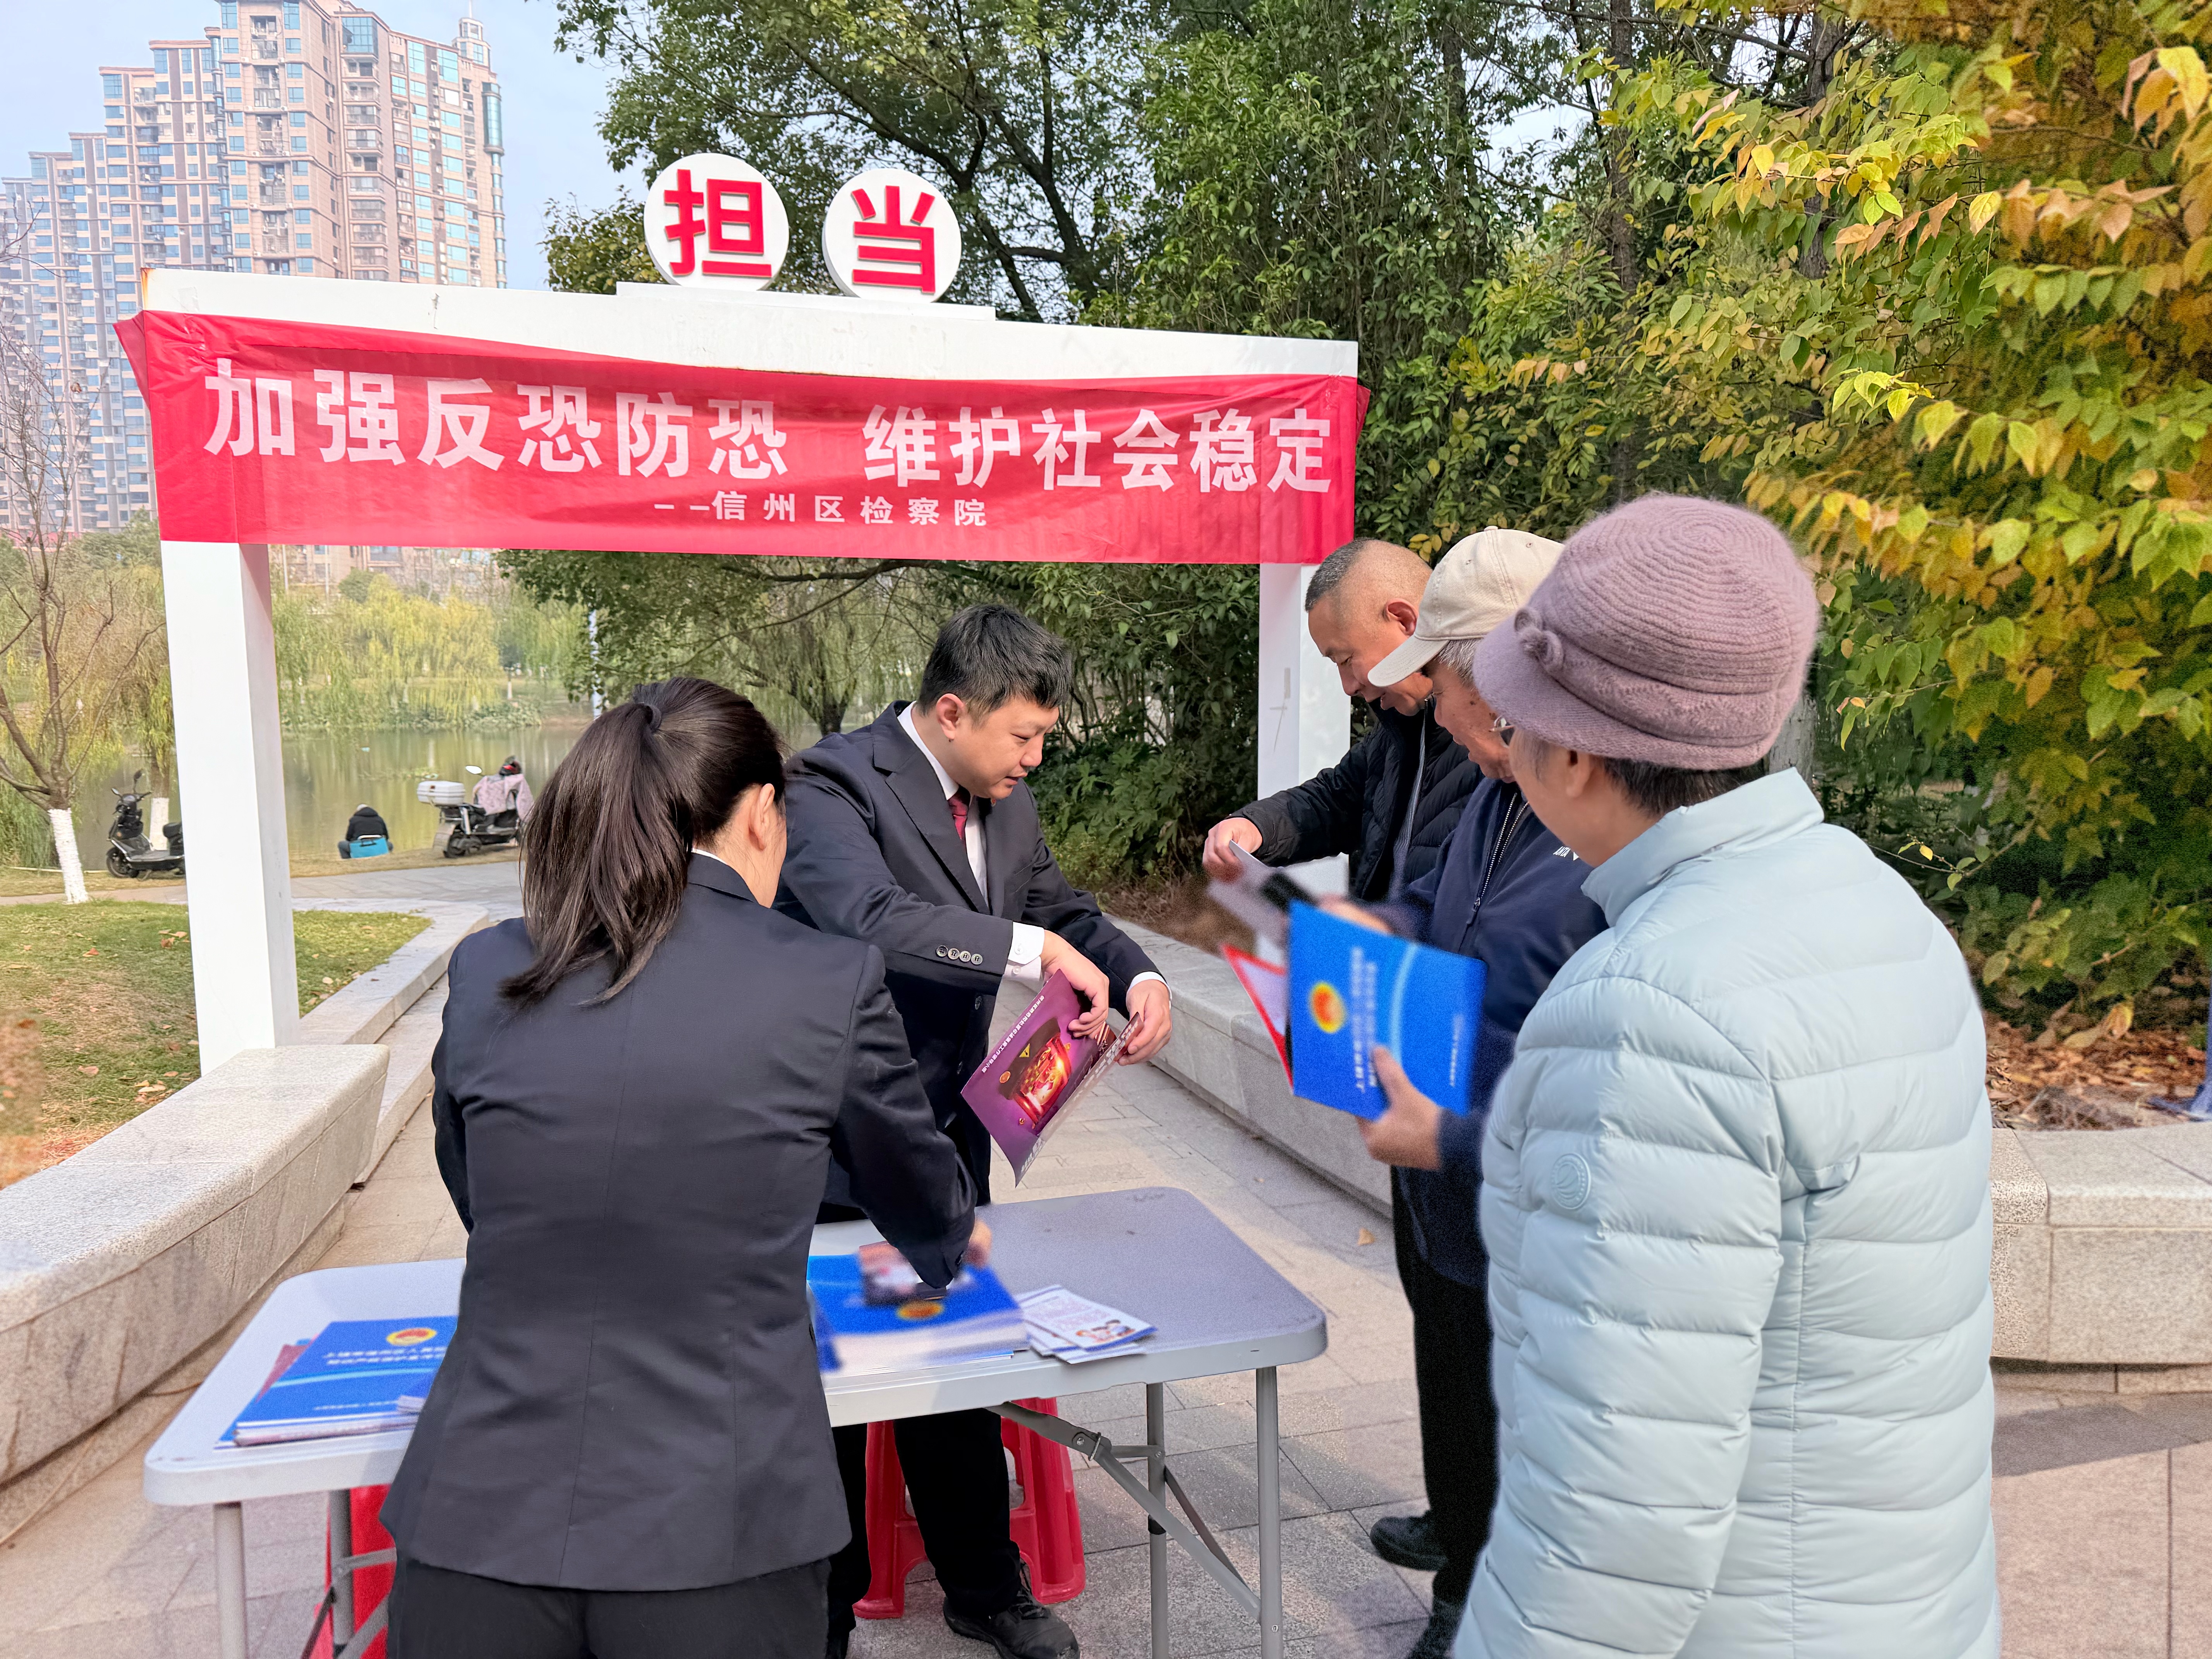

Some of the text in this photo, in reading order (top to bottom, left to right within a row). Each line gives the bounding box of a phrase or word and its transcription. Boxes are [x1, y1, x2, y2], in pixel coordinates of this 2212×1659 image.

[203, 357, 1332, 494] 加强反恐防恐 维护社会稳定
